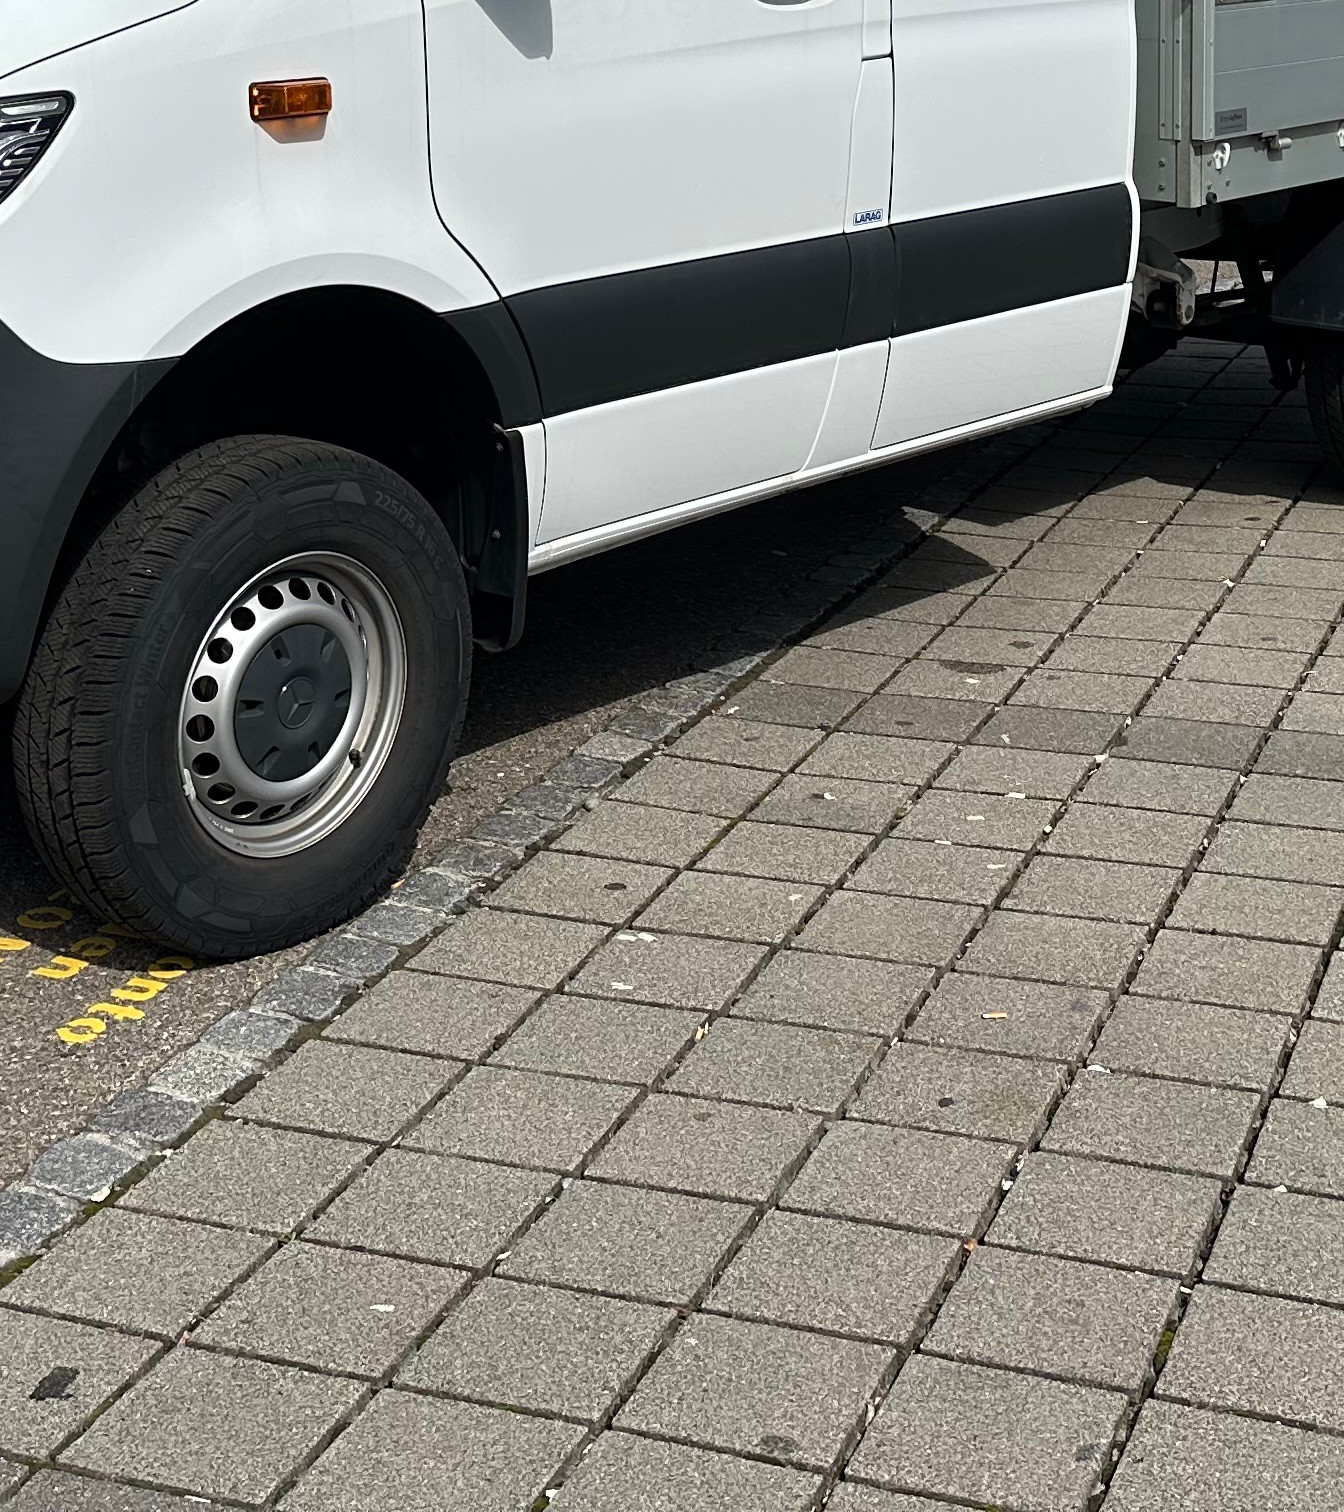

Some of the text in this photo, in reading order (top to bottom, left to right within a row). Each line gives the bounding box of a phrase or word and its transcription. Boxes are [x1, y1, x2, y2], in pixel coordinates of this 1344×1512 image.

[854, 210, 882, 224] LARAG
[374, 490, 418, 530] 225/75
[415, 522, 426, 544] R
[55, 955, 196, 1046] onto
